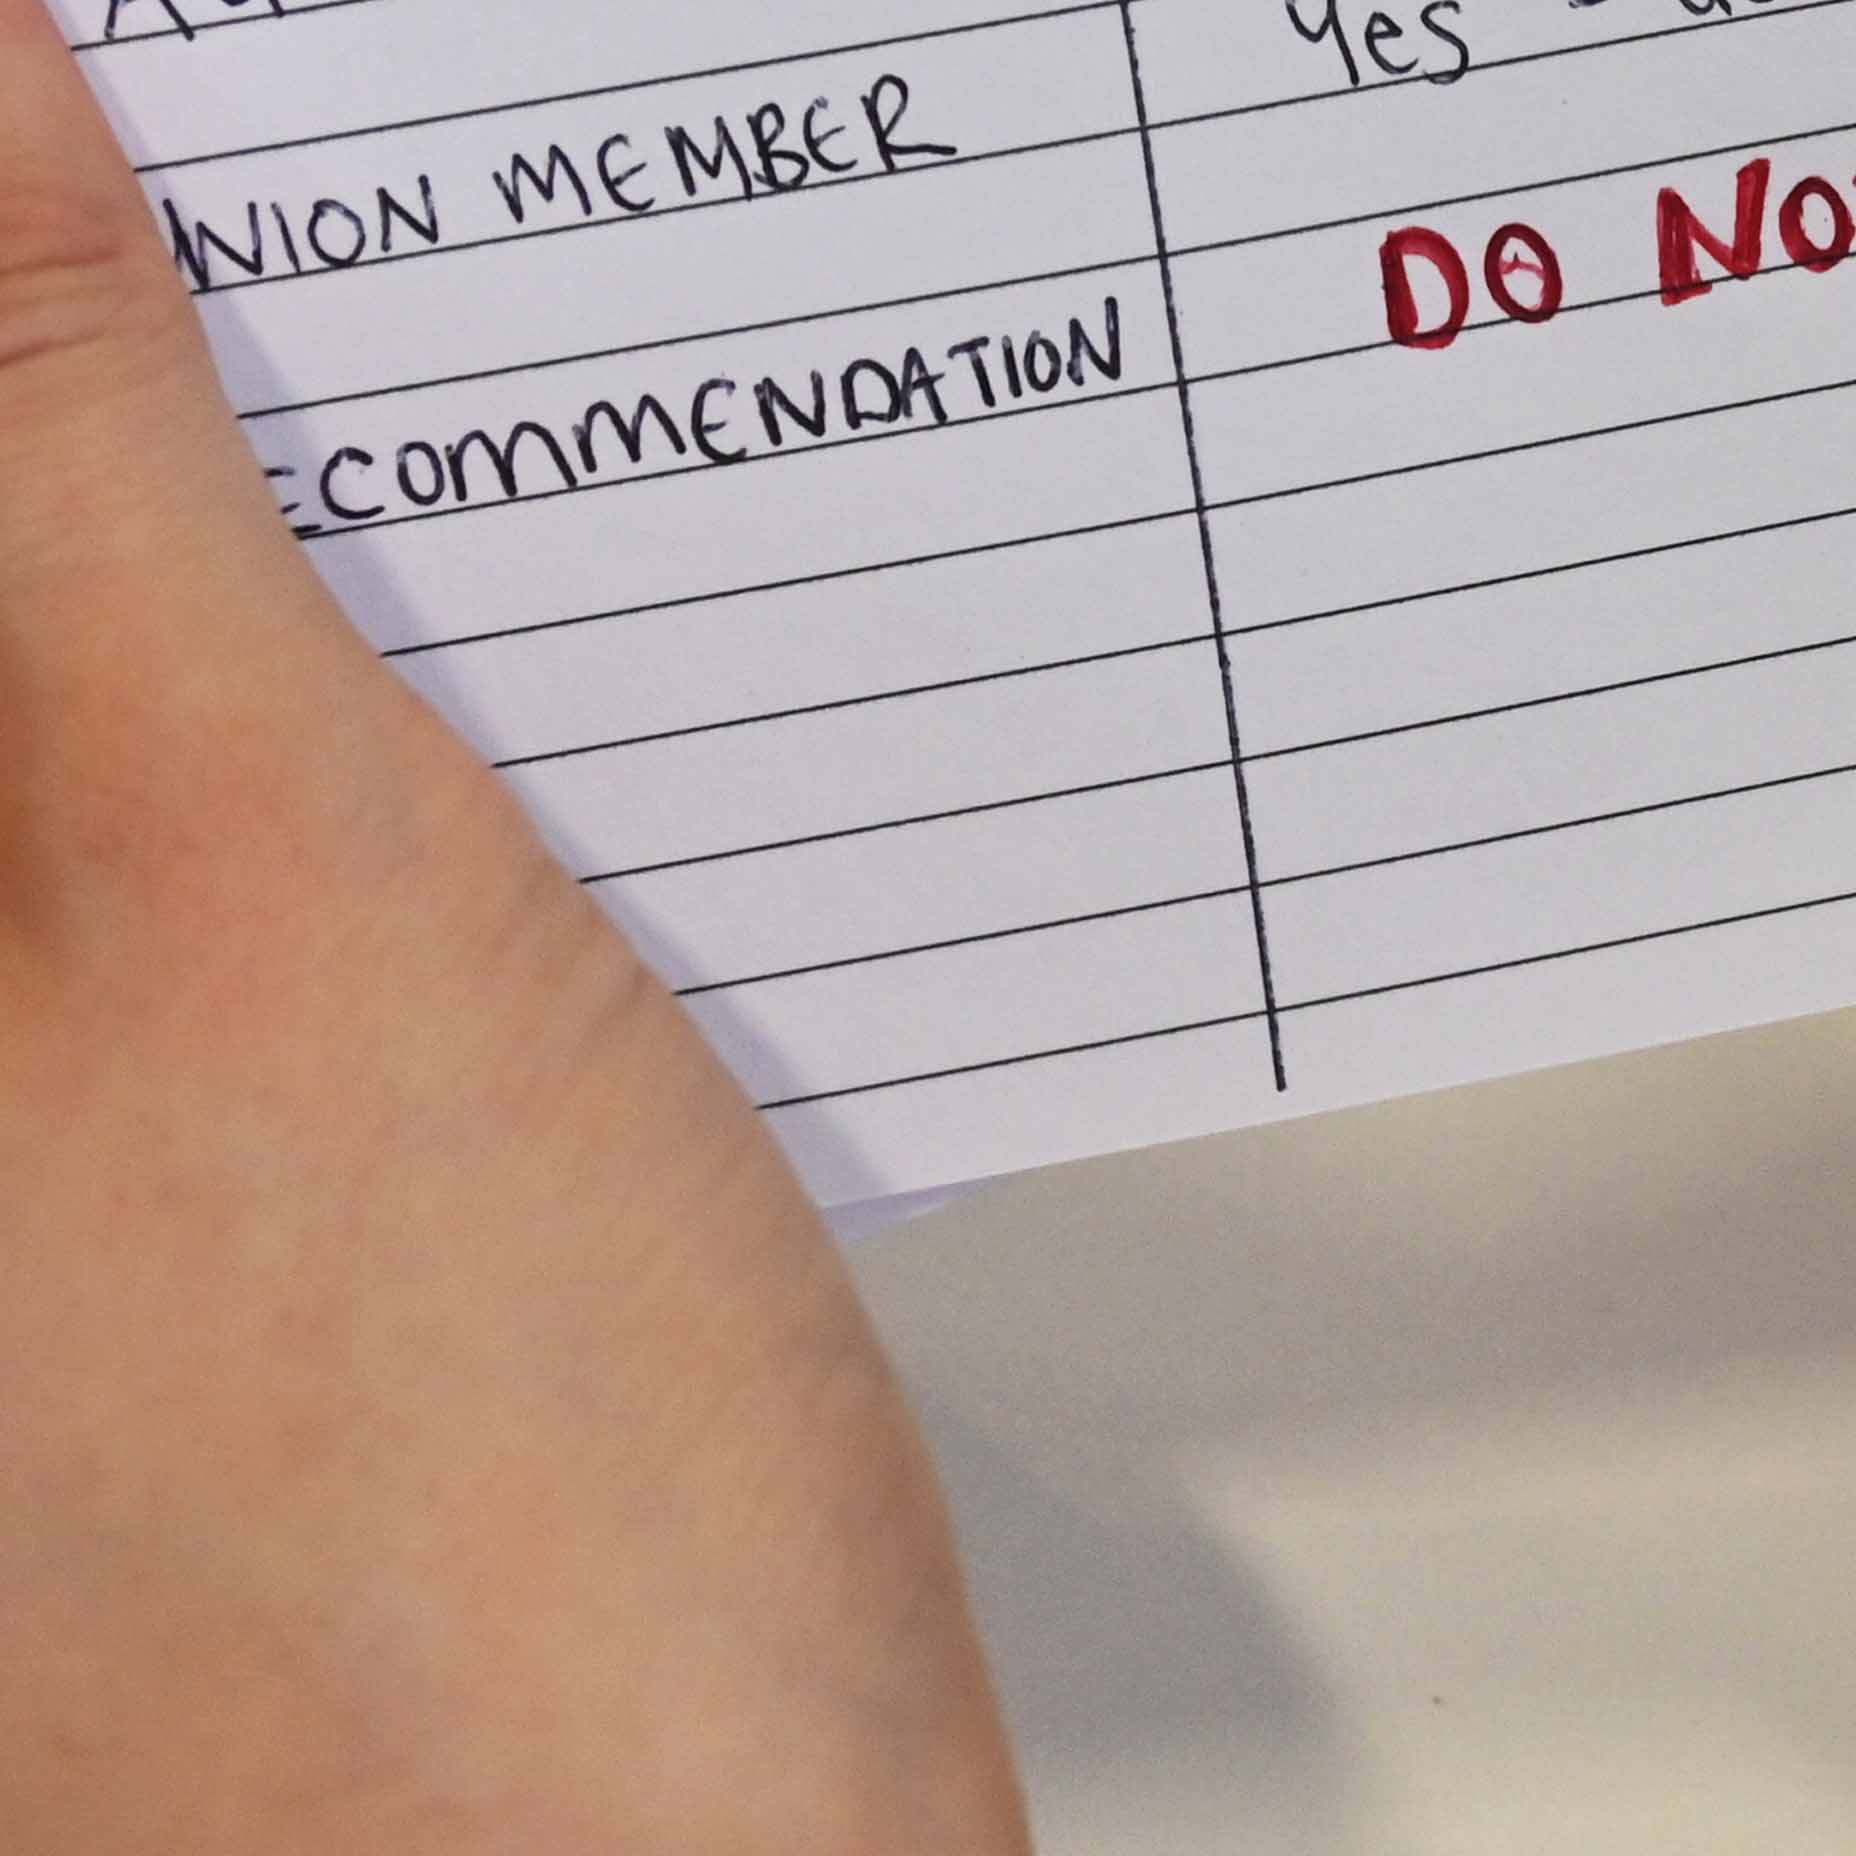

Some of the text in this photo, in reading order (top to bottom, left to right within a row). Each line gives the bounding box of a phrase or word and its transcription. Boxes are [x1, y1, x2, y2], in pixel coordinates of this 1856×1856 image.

[161, 72, 958, 293] NION MEMBER
[1379, 221, 1564, 350] DO
[262, 294, 1124, 532] COMMENDATION
